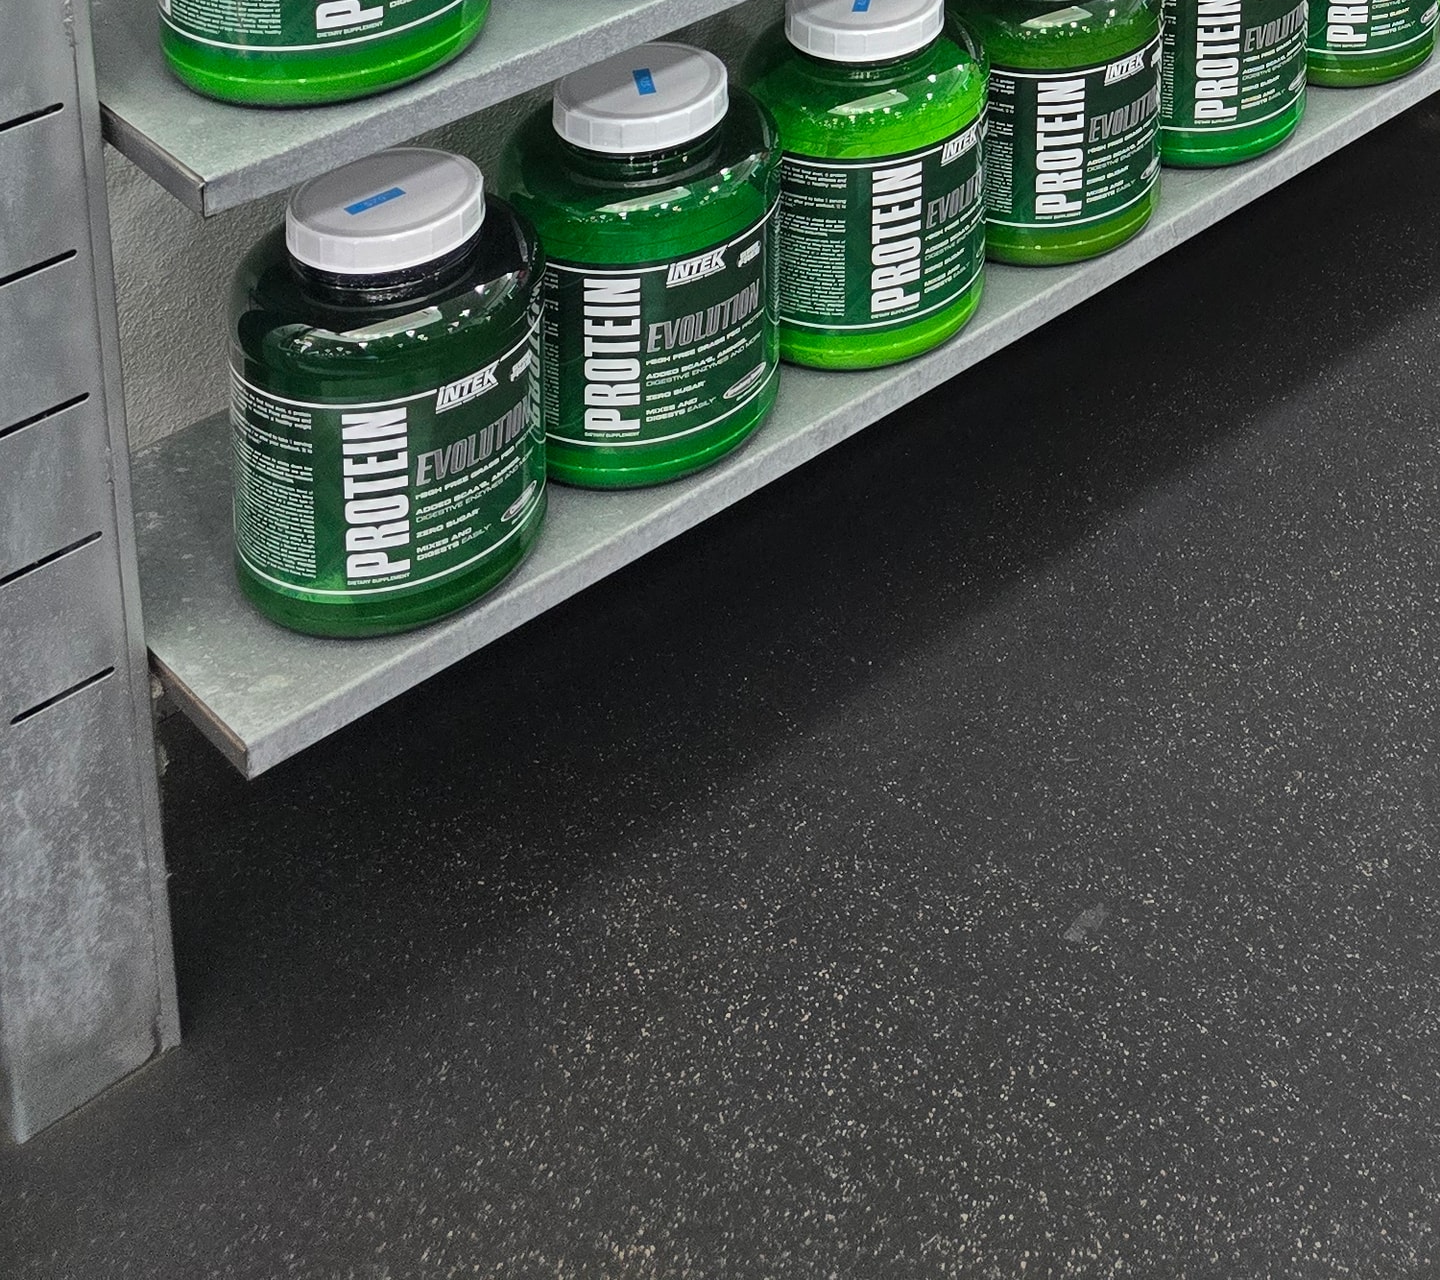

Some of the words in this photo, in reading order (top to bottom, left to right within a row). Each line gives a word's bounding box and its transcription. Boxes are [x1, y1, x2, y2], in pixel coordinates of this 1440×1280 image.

[1104, 53, 1145, 86] INTEK
[1035, 78, 1086, 217] PROTEIN
[666, 245, 727, 285] INTEK
[871, 161, 923, 313] PROTEIN
[584, 277, 640, 430] PROTEIN
[647, 278, 760, 353] EVOLUTION
[436, 362, 499, 412] INTEK
[341, 407, 410, 578] PROTEIN
